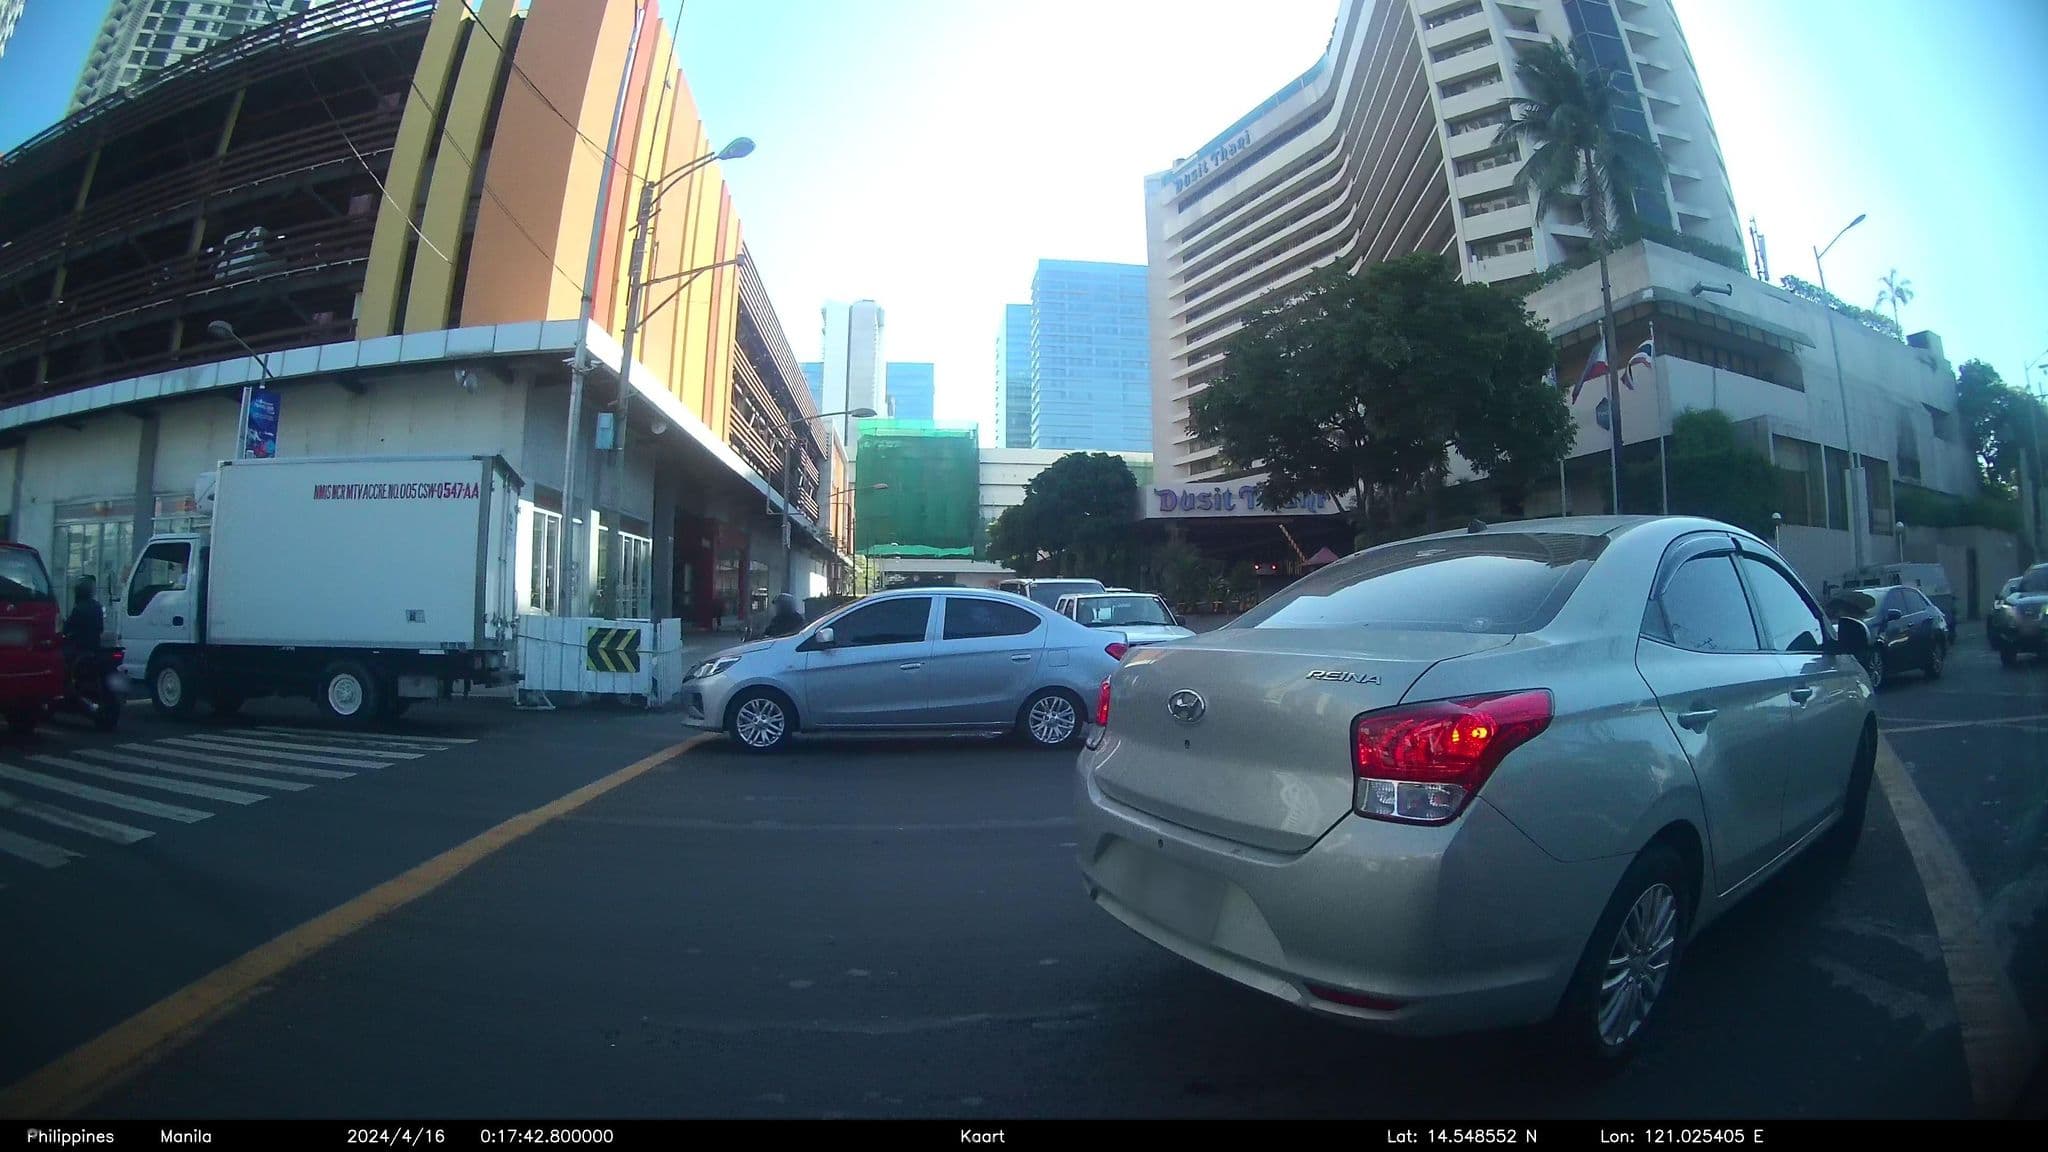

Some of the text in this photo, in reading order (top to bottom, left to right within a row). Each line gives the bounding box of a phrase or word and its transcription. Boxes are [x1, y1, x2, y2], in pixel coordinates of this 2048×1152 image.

[1174, 130, 1251, 195] Dusit Thani
[1153, 487, 1236, 512] Dusit
[1305, 670, 1382, 686] REINA
